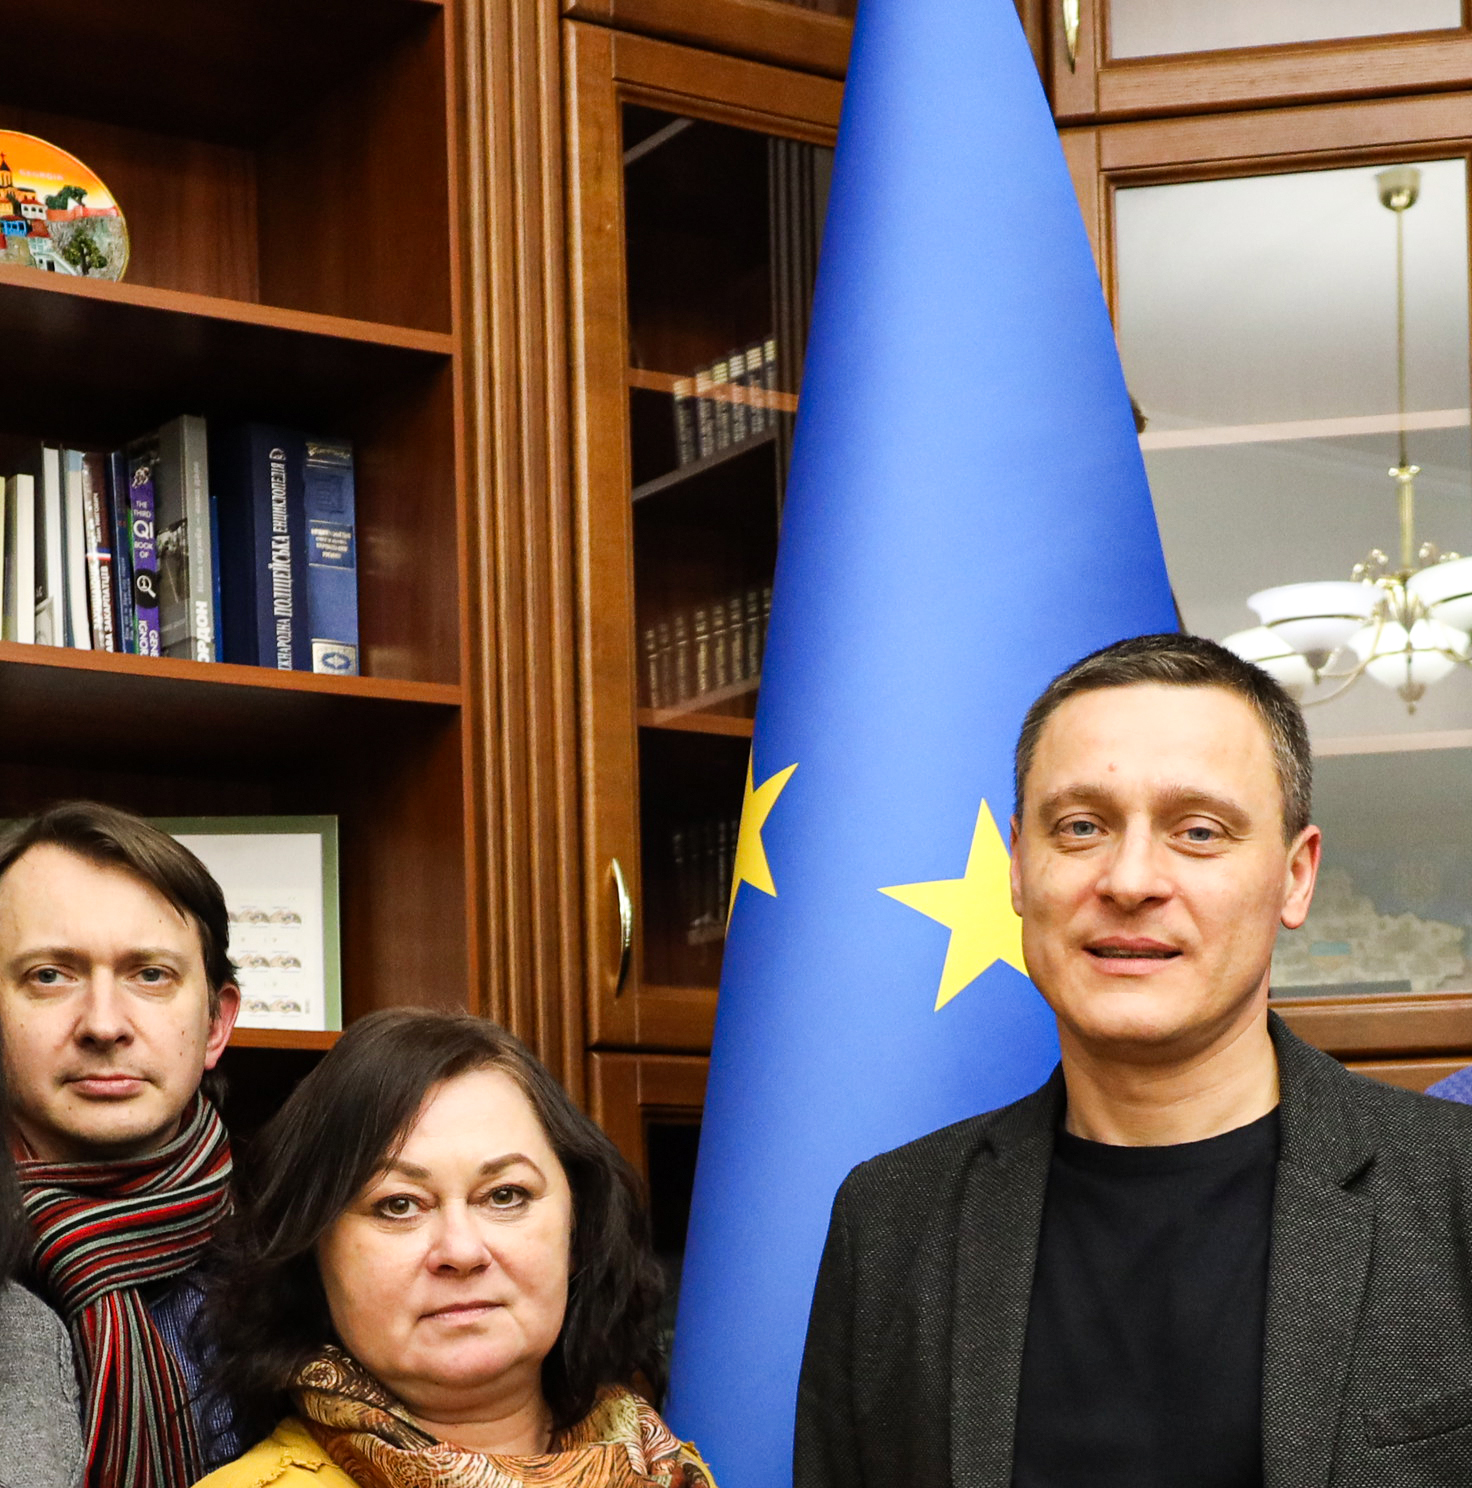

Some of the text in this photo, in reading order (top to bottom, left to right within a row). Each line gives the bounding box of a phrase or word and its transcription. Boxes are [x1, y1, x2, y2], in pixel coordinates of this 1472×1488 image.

[271, 462, 288, 534] ЕНЦИКЛОПЕДІЯ
[136, 501, 148, 509] THE
[134, 509, 152, 518] THIRD
[133, 520, 154, 540] QI
[134, 541, 153, 550] BOOK
[139, 551, 149, 559] OF
[268, 535, 294, 618] ПОЛІЦЕЙСЬКА
